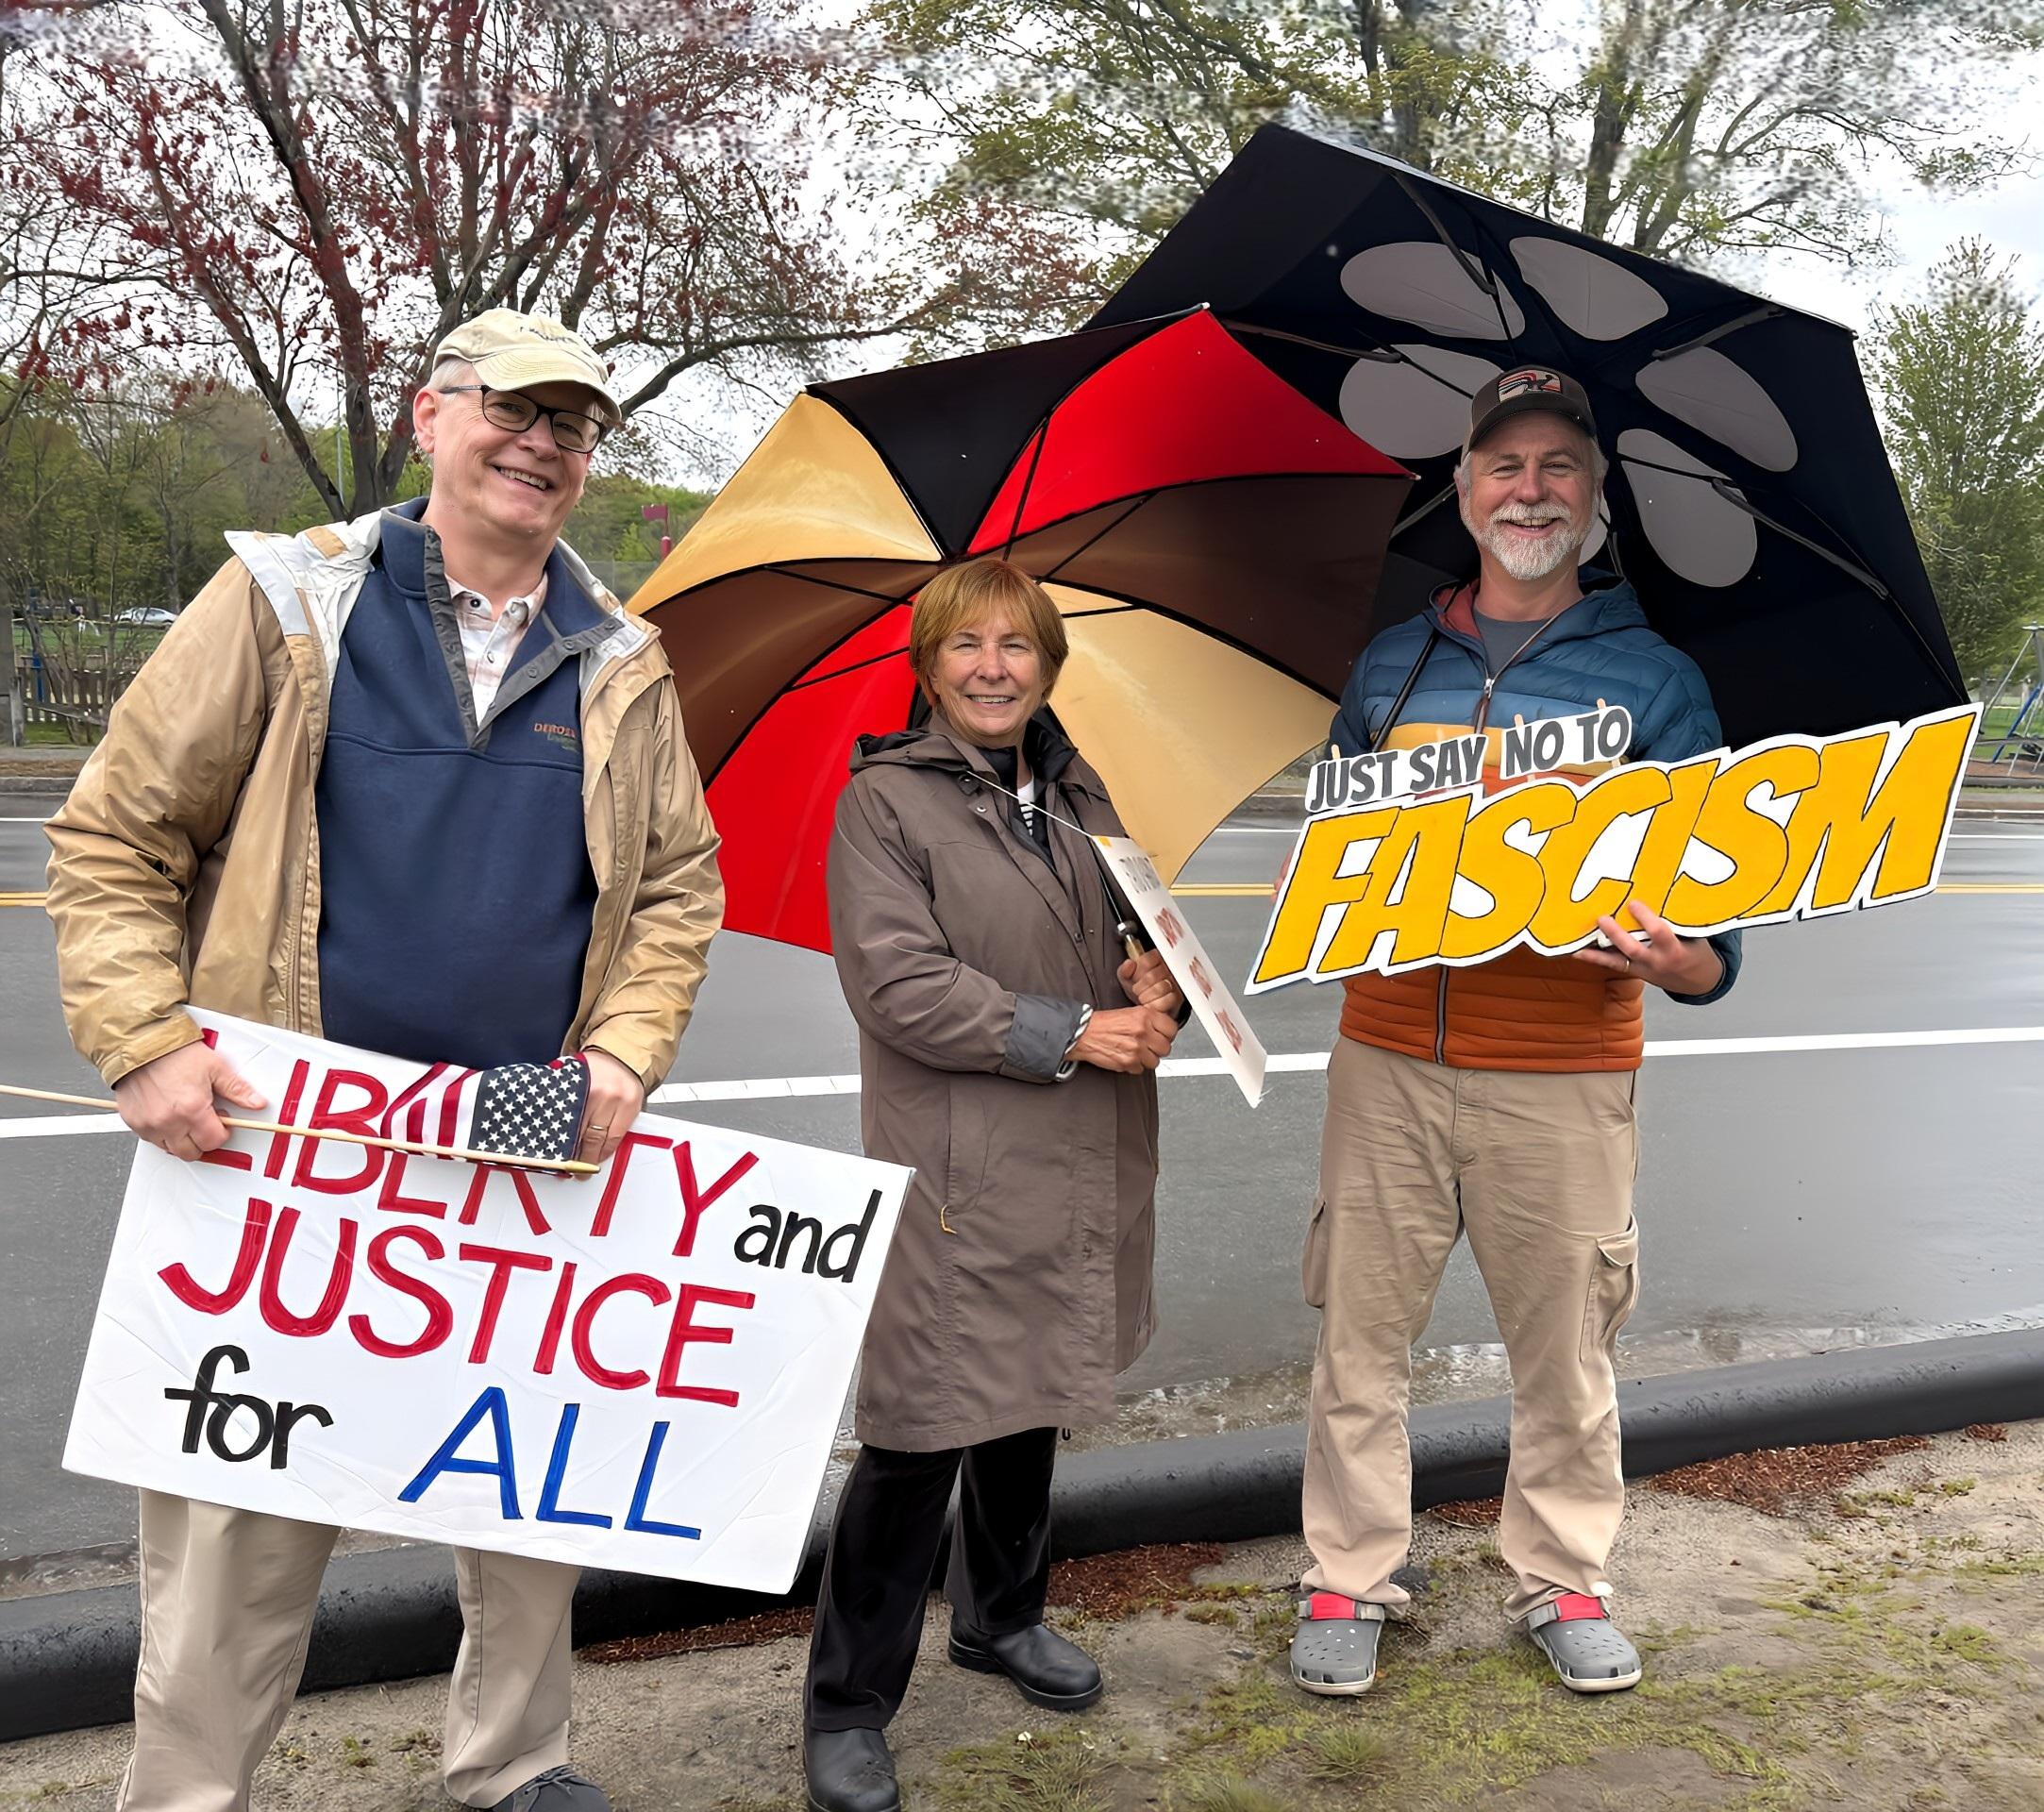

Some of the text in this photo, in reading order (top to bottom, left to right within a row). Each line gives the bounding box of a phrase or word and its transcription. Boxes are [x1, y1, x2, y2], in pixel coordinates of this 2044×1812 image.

[1256, 713, 1975, 982] FASCISM
[1310, 708, 1630, 812] JUST SAY NO TO
[158, 1198, 756, 1408] JUSTICE
[734, 1189, 882, 1283] and
[164, 1345, 701, 1540] for ALL
